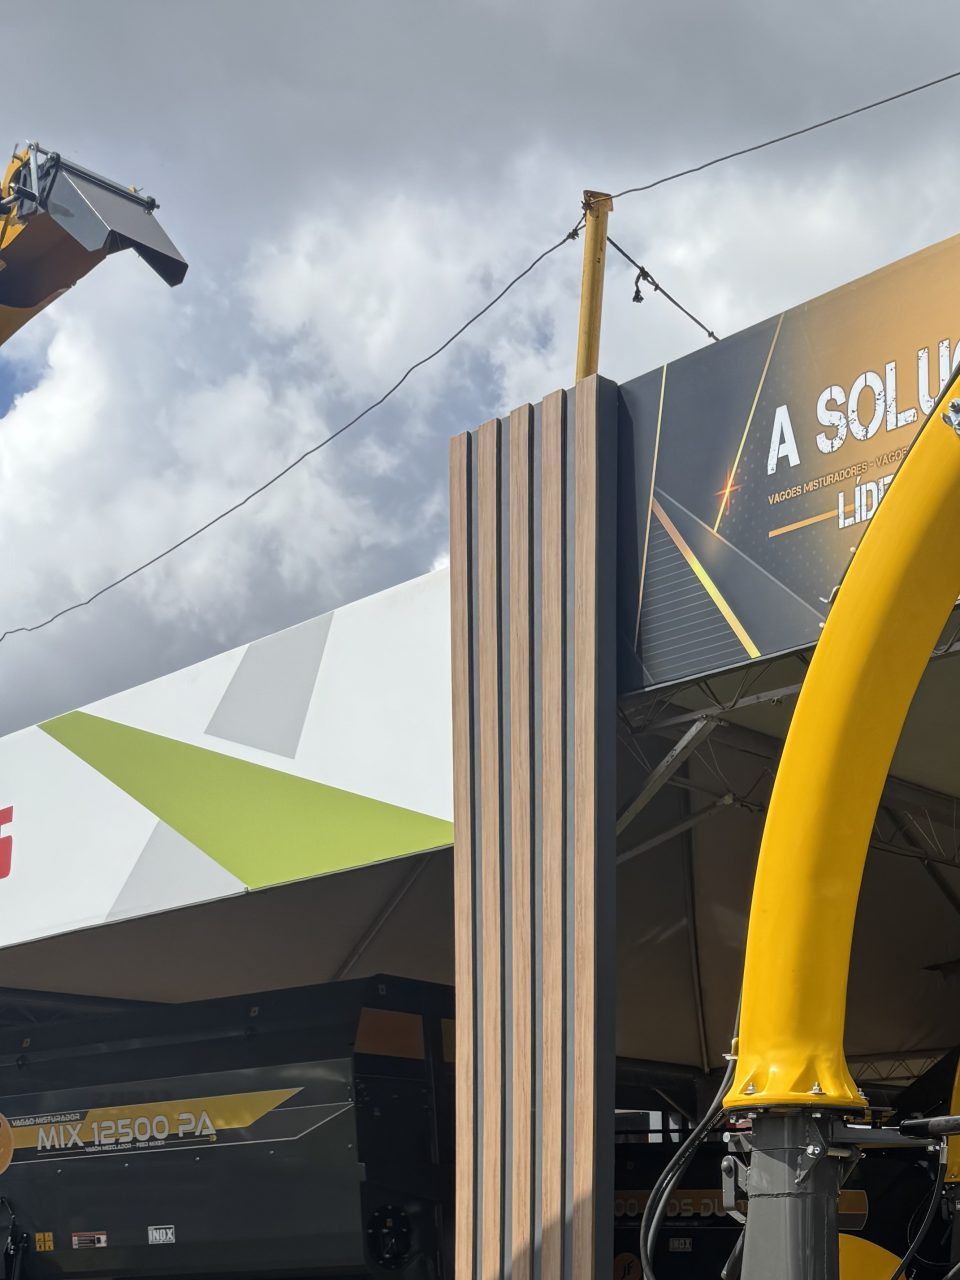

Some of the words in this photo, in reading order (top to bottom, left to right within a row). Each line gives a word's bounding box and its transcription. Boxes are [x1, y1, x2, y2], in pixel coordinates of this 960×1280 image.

[768, 404, 801, 475] A
[803, 462, 869, 496] MISTURADORES
[37, 1122, 84, 1151] MIX
[92, 1115, 169, 1145] 12500
[178, 1110, 217, 1138] PA
